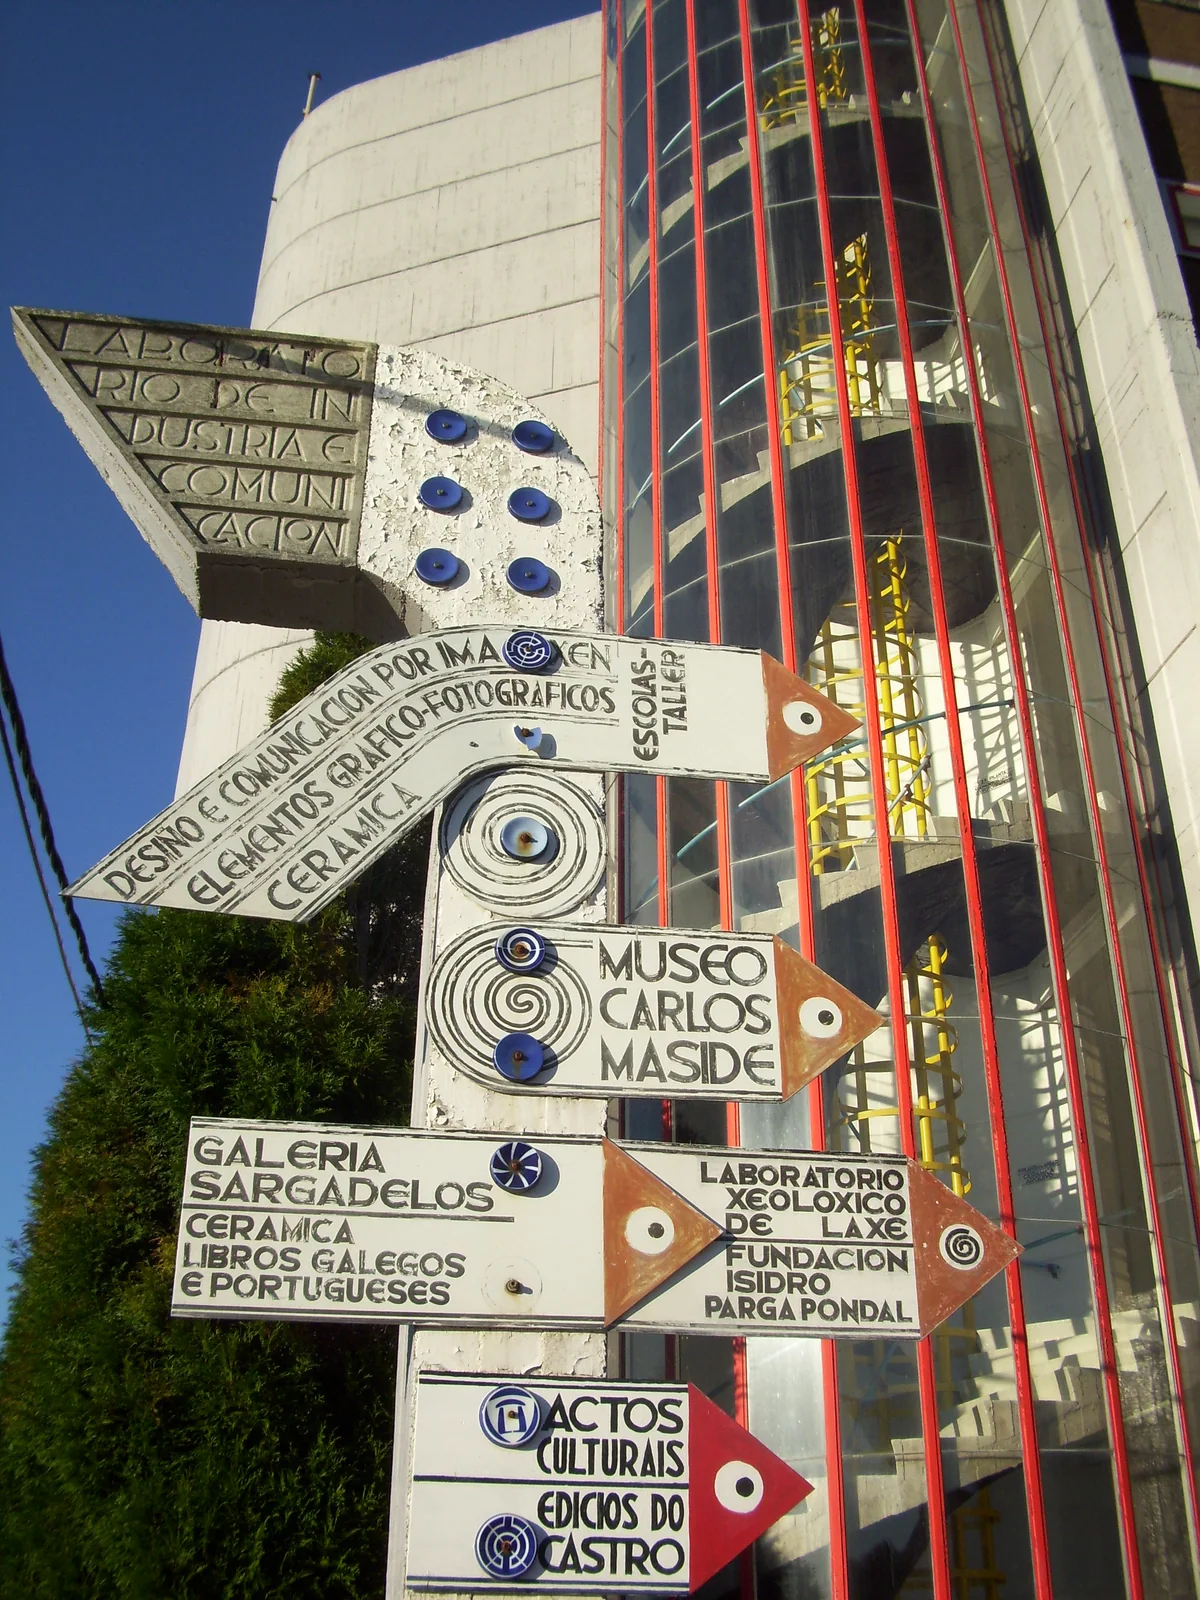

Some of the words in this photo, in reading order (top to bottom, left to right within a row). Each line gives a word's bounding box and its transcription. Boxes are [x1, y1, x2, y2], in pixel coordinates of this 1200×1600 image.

[59, 323, 360, 378] LABORATO
[94, 365, 181, 403] RIO
[210, 378, 275, 413] DE
[309, 388, 353, 422] IN
[130, 412, 308, 461] DUSTRIA
[322, 434, 353, 463] E
[159, 463, 347, 510] COMUNI
[198, 511, 342, 557] CACION
[661, 650, 688, 736] TALLER
[198, 796, 229, 823] E
[219, 674, 383, 807] COMUNICACION
[375, 647, 438, 690] POR
[187, 780, 335, 905] ELEMENTOS
[267, 782, 422, 911] CERAMICA
[599, 937, 768, 987] MUSEO
[600, 987, 772, 1035] CARLOS
[601, 1036, 775, 1087] MASIDE
[193, 1135, 386, 1174] GALERIA
[190, 1170, 494, 1212] SARGADELOS
[700, 1161, 905, 1191] LABORATORIO
[725, 1187, 907, 1216] XEOLOXICO
[186, 1213, 355, 1244] CERAMICA
[725, 1213, 773, 1236] DE
[821, 1216, 908, 1240] LAXE
[183, 1243, 302, 1272] LIBROS
[311, 1248, 466, 1278] GALEGOS
[725, 1243, 909, 1274] FUNDACION
[180, 1272, 202, 1297] E
[210, 1273, 450, 1305] PORTUGUESES
[726, 1269, 831, 1296] ISIDRO
[704, 1295, 796, 1321] PARGA
[801, 1296, 913, 1325] PONDAL
[541, 1392, 684, 1434] ACTOS
[537, 1436, 684, 1477] CULTURAIS
[537, 1491, 639, 1530] EDICIOS
[651, 1493, 684, 1532] DO
[537, 1532, 685, 1575] CASTRO
